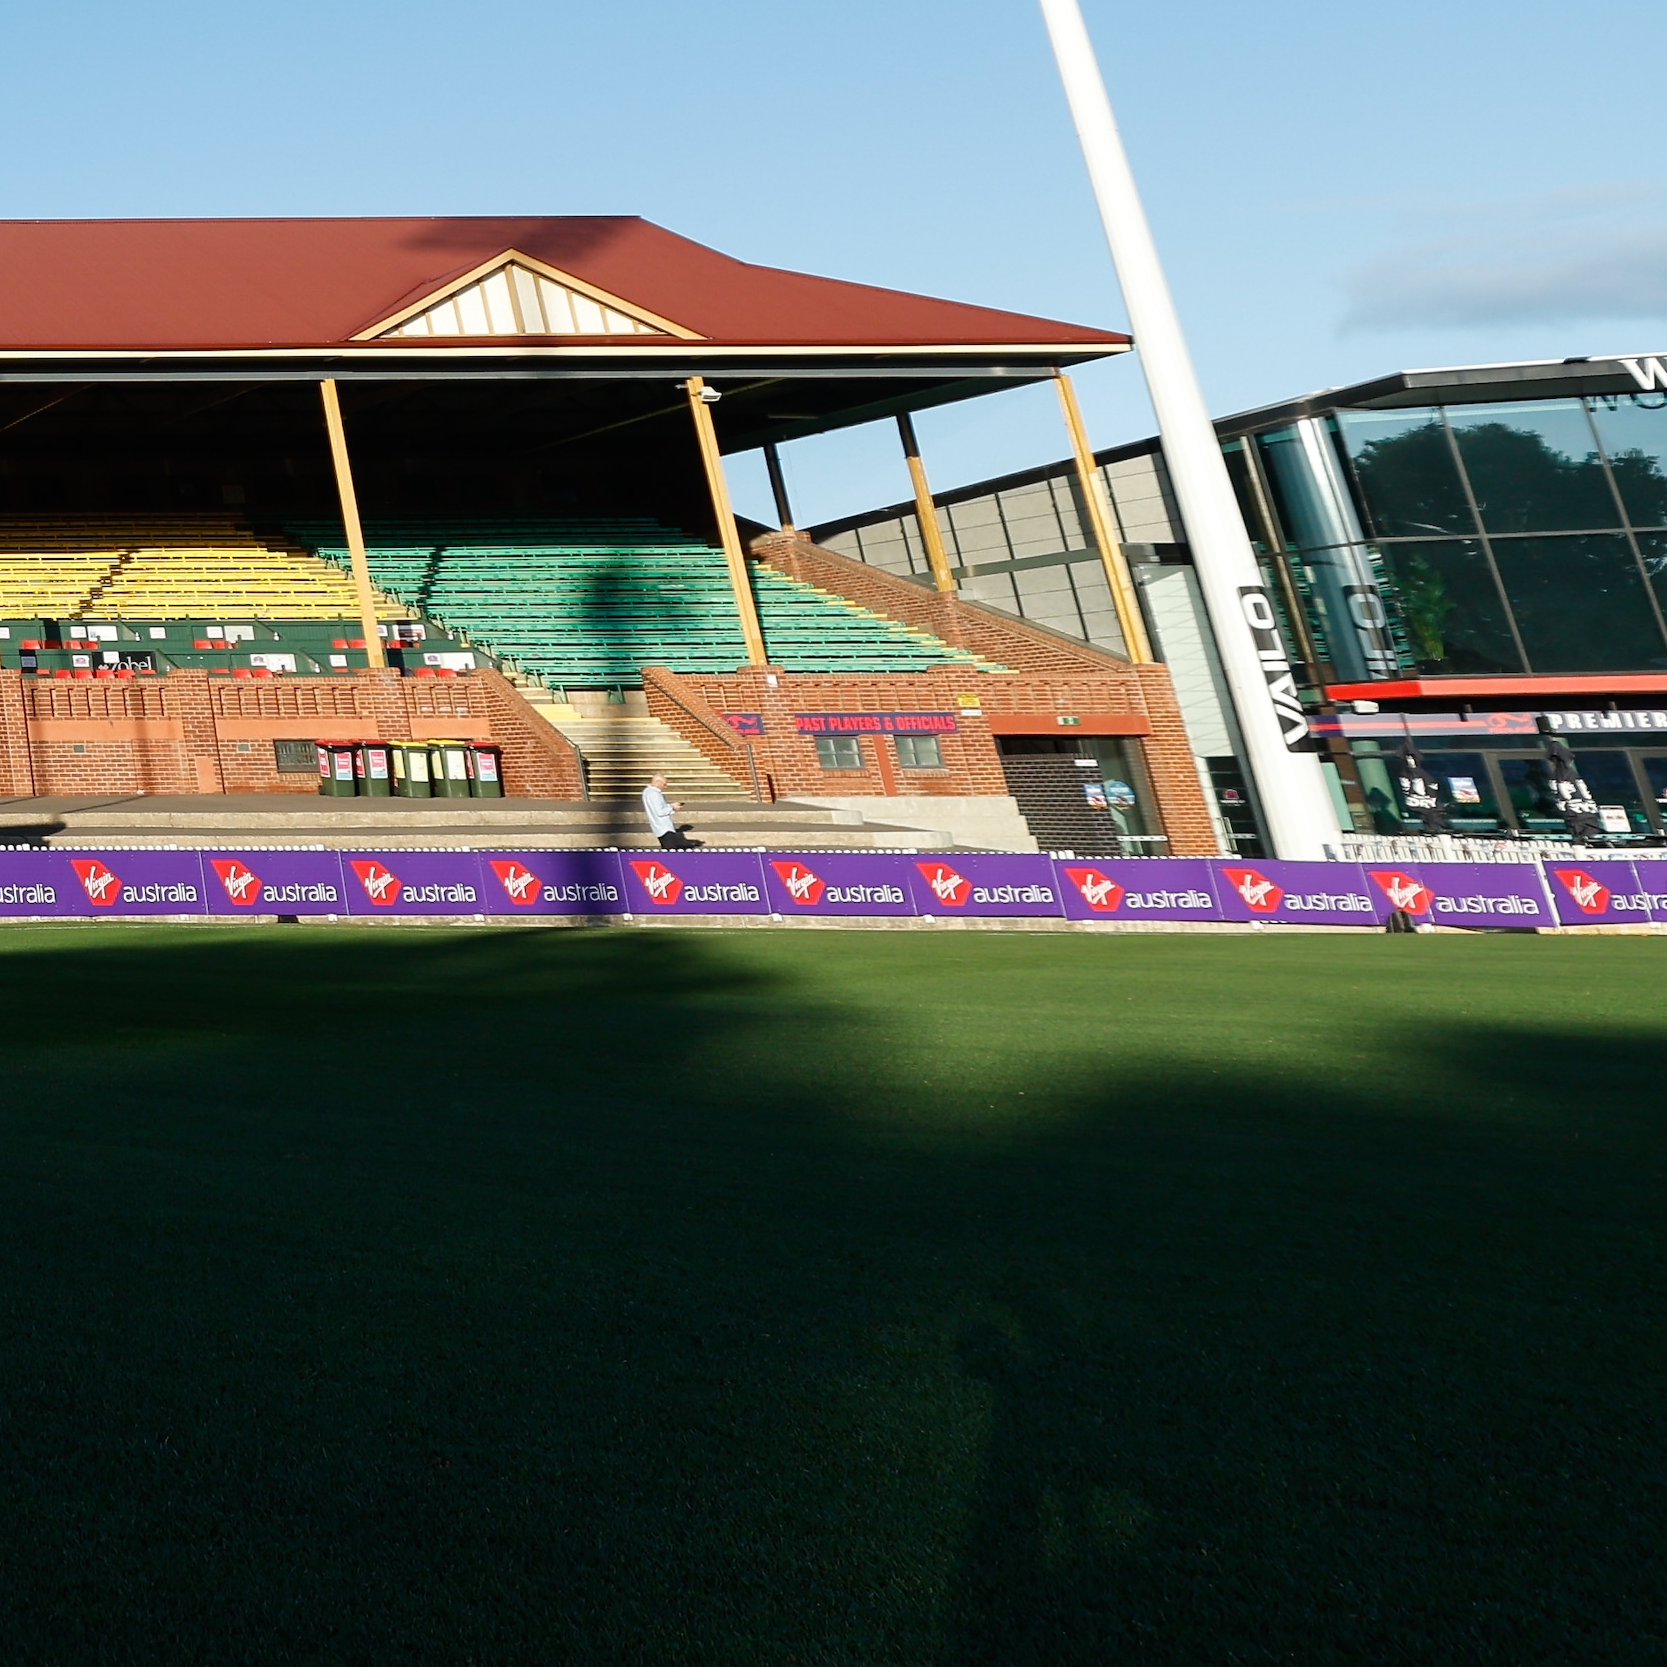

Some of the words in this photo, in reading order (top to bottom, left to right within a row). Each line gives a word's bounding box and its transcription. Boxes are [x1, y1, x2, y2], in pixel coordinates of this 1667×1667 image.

[1241, 593, 1310, 746] VAILO
[796, 716, 825, 731] PAST
[828, 716, 882, 731] PLAYERS
[895, 715, 956, 731] OFFICIALS
[1547, 712, 1667, 729] PREMIER
[84, 866, 114, 900] Virgin
[123, 883, 198, 903] australia
[225, 866, 254, 899] Virgin
[263, 883, 338, 903] australia
[365, 867, 394, 899] Virgin
[402, 883, 477, 903] australia
[504, 867, 535, 899] Virgin
[543, 883, 619, 902] australia
[644, 867, 675, 898] Virgin
[684, 883, 760, 902] australia
[786, 868, 817, 899] Virgin
[826, 884, 905, 904] australia
[932, 869, 963, 900] Virgin
[973, 884, 1054, 904] australia
[1125, 889, 1213, 909] australia
[1283, 892, 1374, 912] australia
[1435, 894, 1540, 915] australia
